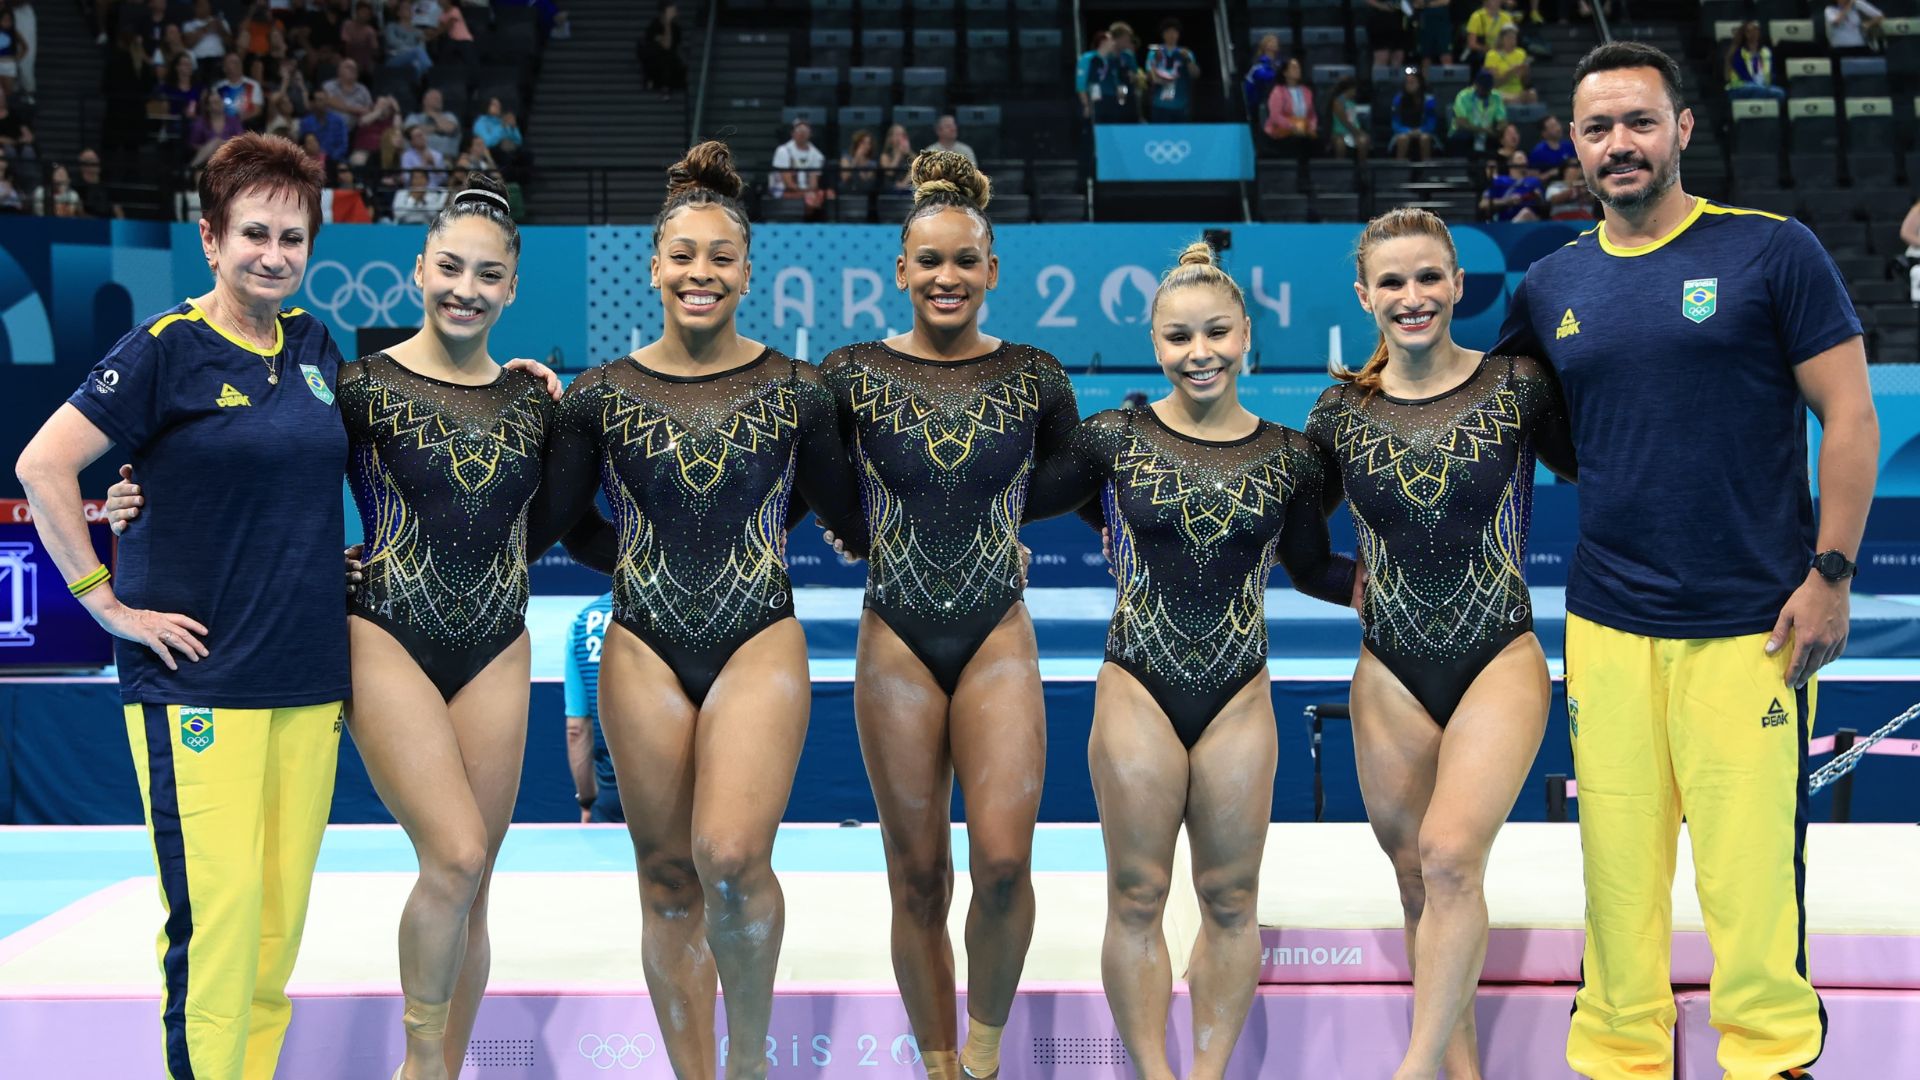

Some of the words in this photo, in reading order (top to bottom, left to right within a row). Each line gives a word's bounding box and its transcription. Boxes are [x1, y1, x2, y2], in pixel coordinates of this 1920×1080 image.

[1556, 321, 1581, 340] PEAK
[180, 707, 213, 715] BRASIL
[1761, 711, 1789, 728] PEAK
[1260, 946, 1362, 966] YMNOVA
